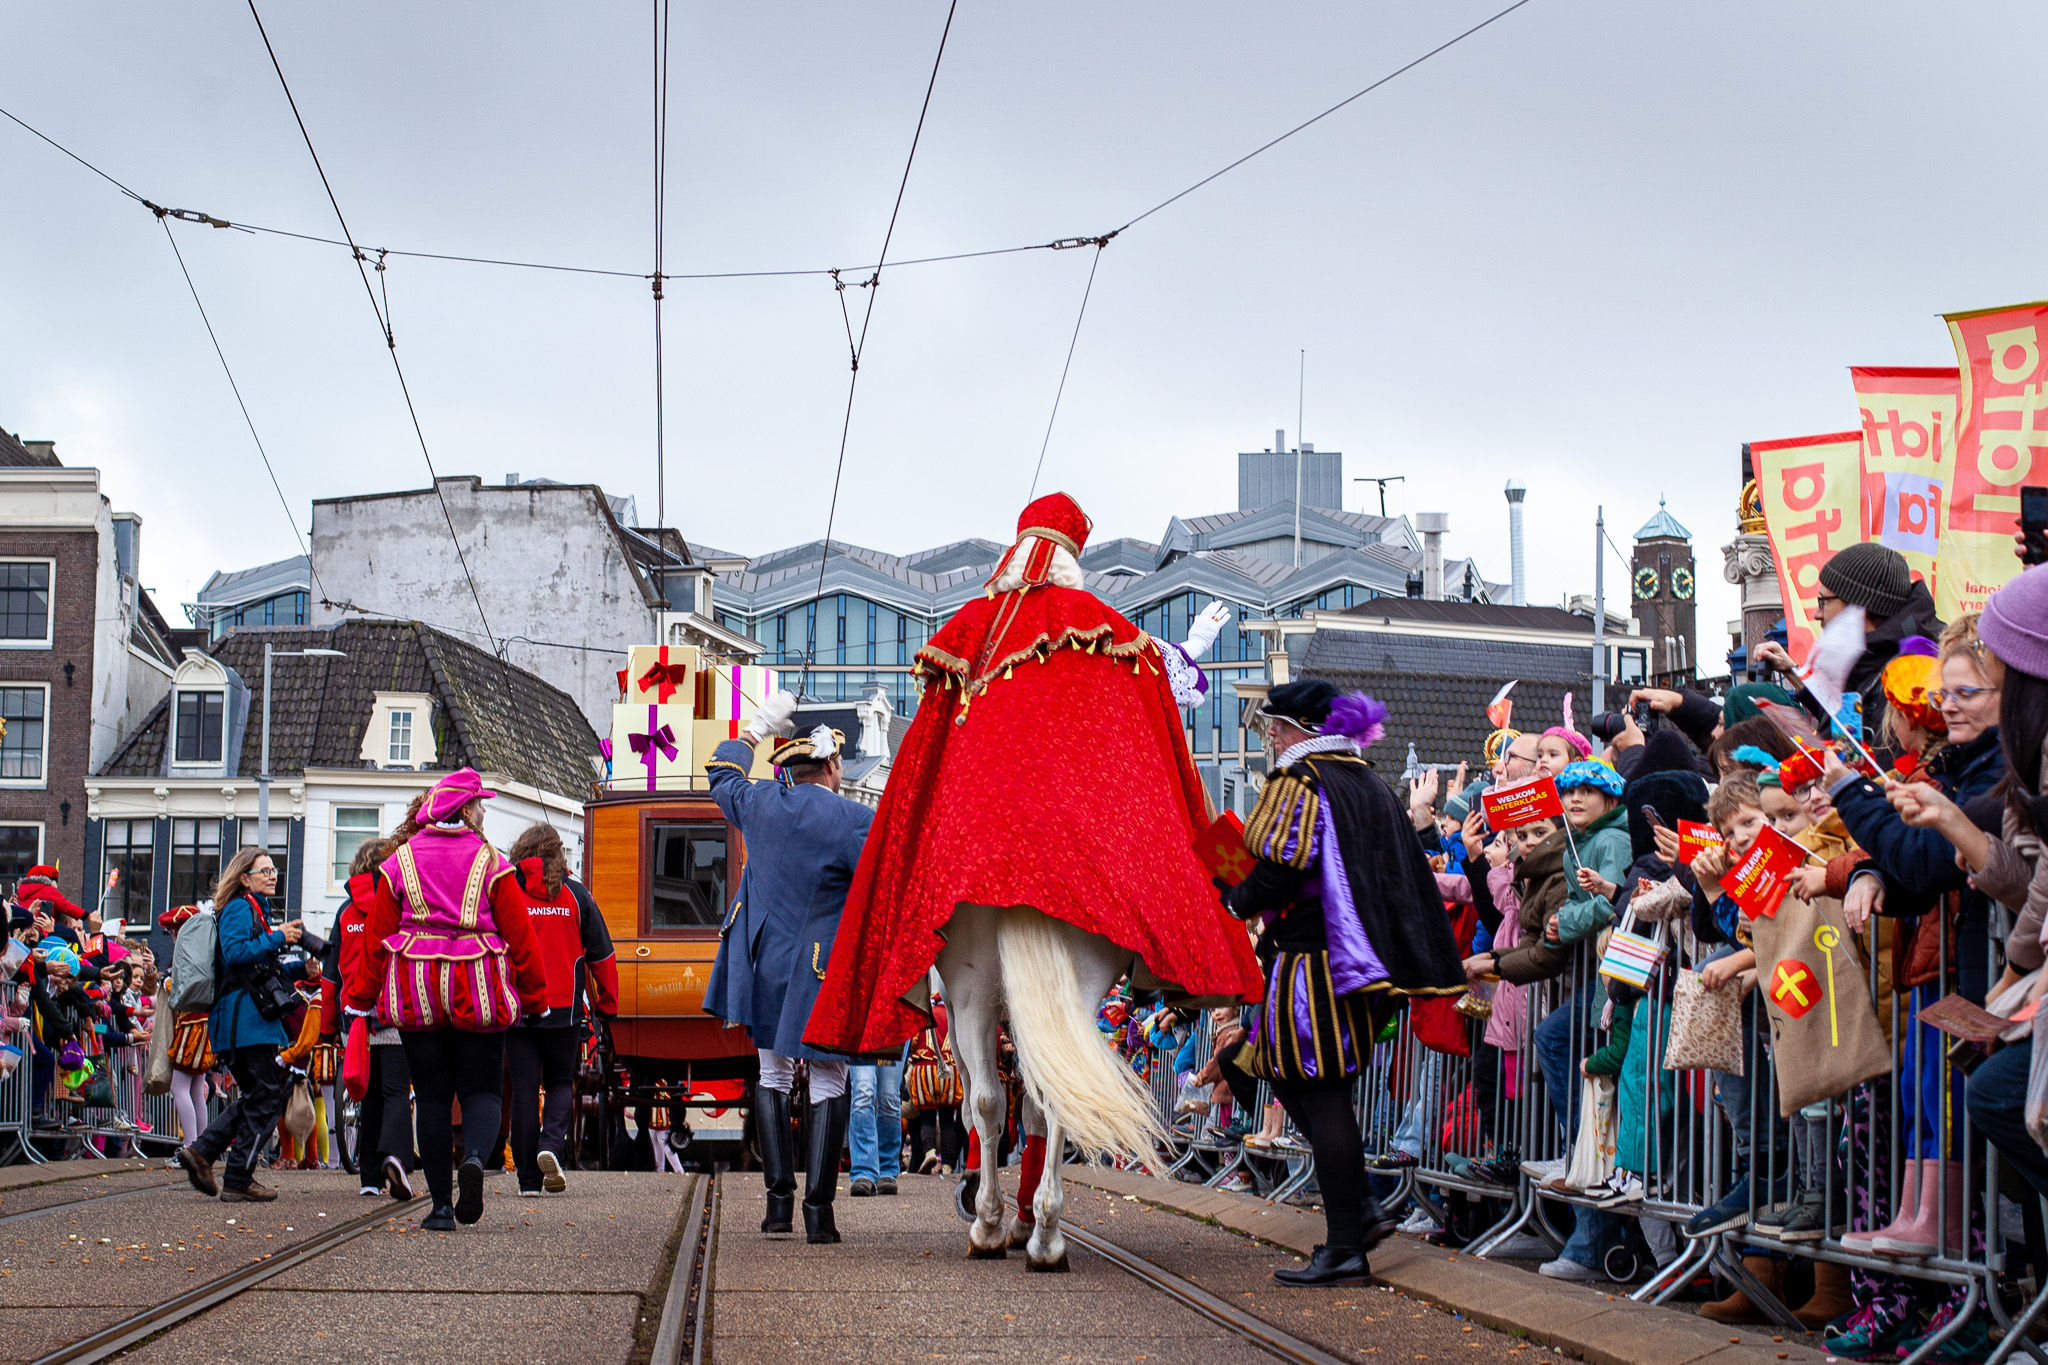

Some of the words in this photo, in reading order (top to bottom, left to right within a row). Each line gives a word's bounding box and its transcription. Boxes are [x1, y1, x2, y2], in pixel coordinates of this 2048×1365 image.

[1489, 791, 1548, 813] SINTERKLAAS
[1496, 787, 1536, 804] WELKOM
[1734, 847, 1773, 898] SINTERKLAAS
[1735, 846, 1764, 882] WELKOM
